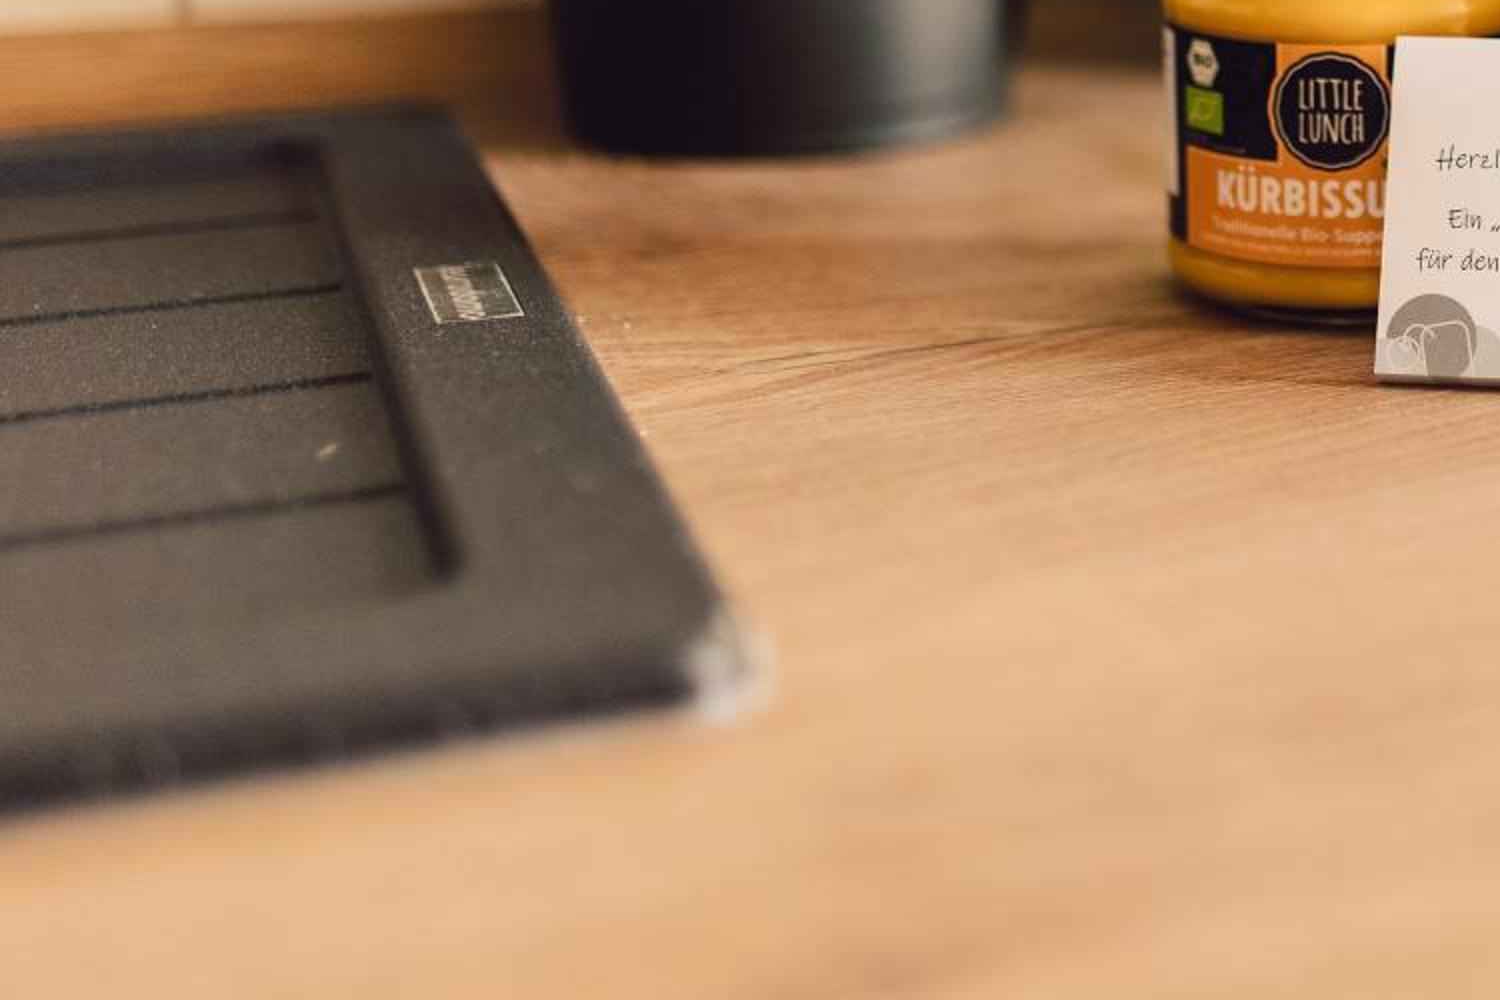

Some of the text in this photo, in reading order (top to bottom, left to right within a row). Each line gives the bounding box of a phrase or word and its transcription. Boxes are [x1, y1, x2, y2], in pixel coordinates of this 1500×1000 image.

[1299, 78, 1364, 110] LITTLE
[1299, 112, 1365, 144] LUNCH
[1447, 208, 1482, 230] Ein
[1415, 247, 1453, 273] für
[1459, 247, 1500, 273] den
